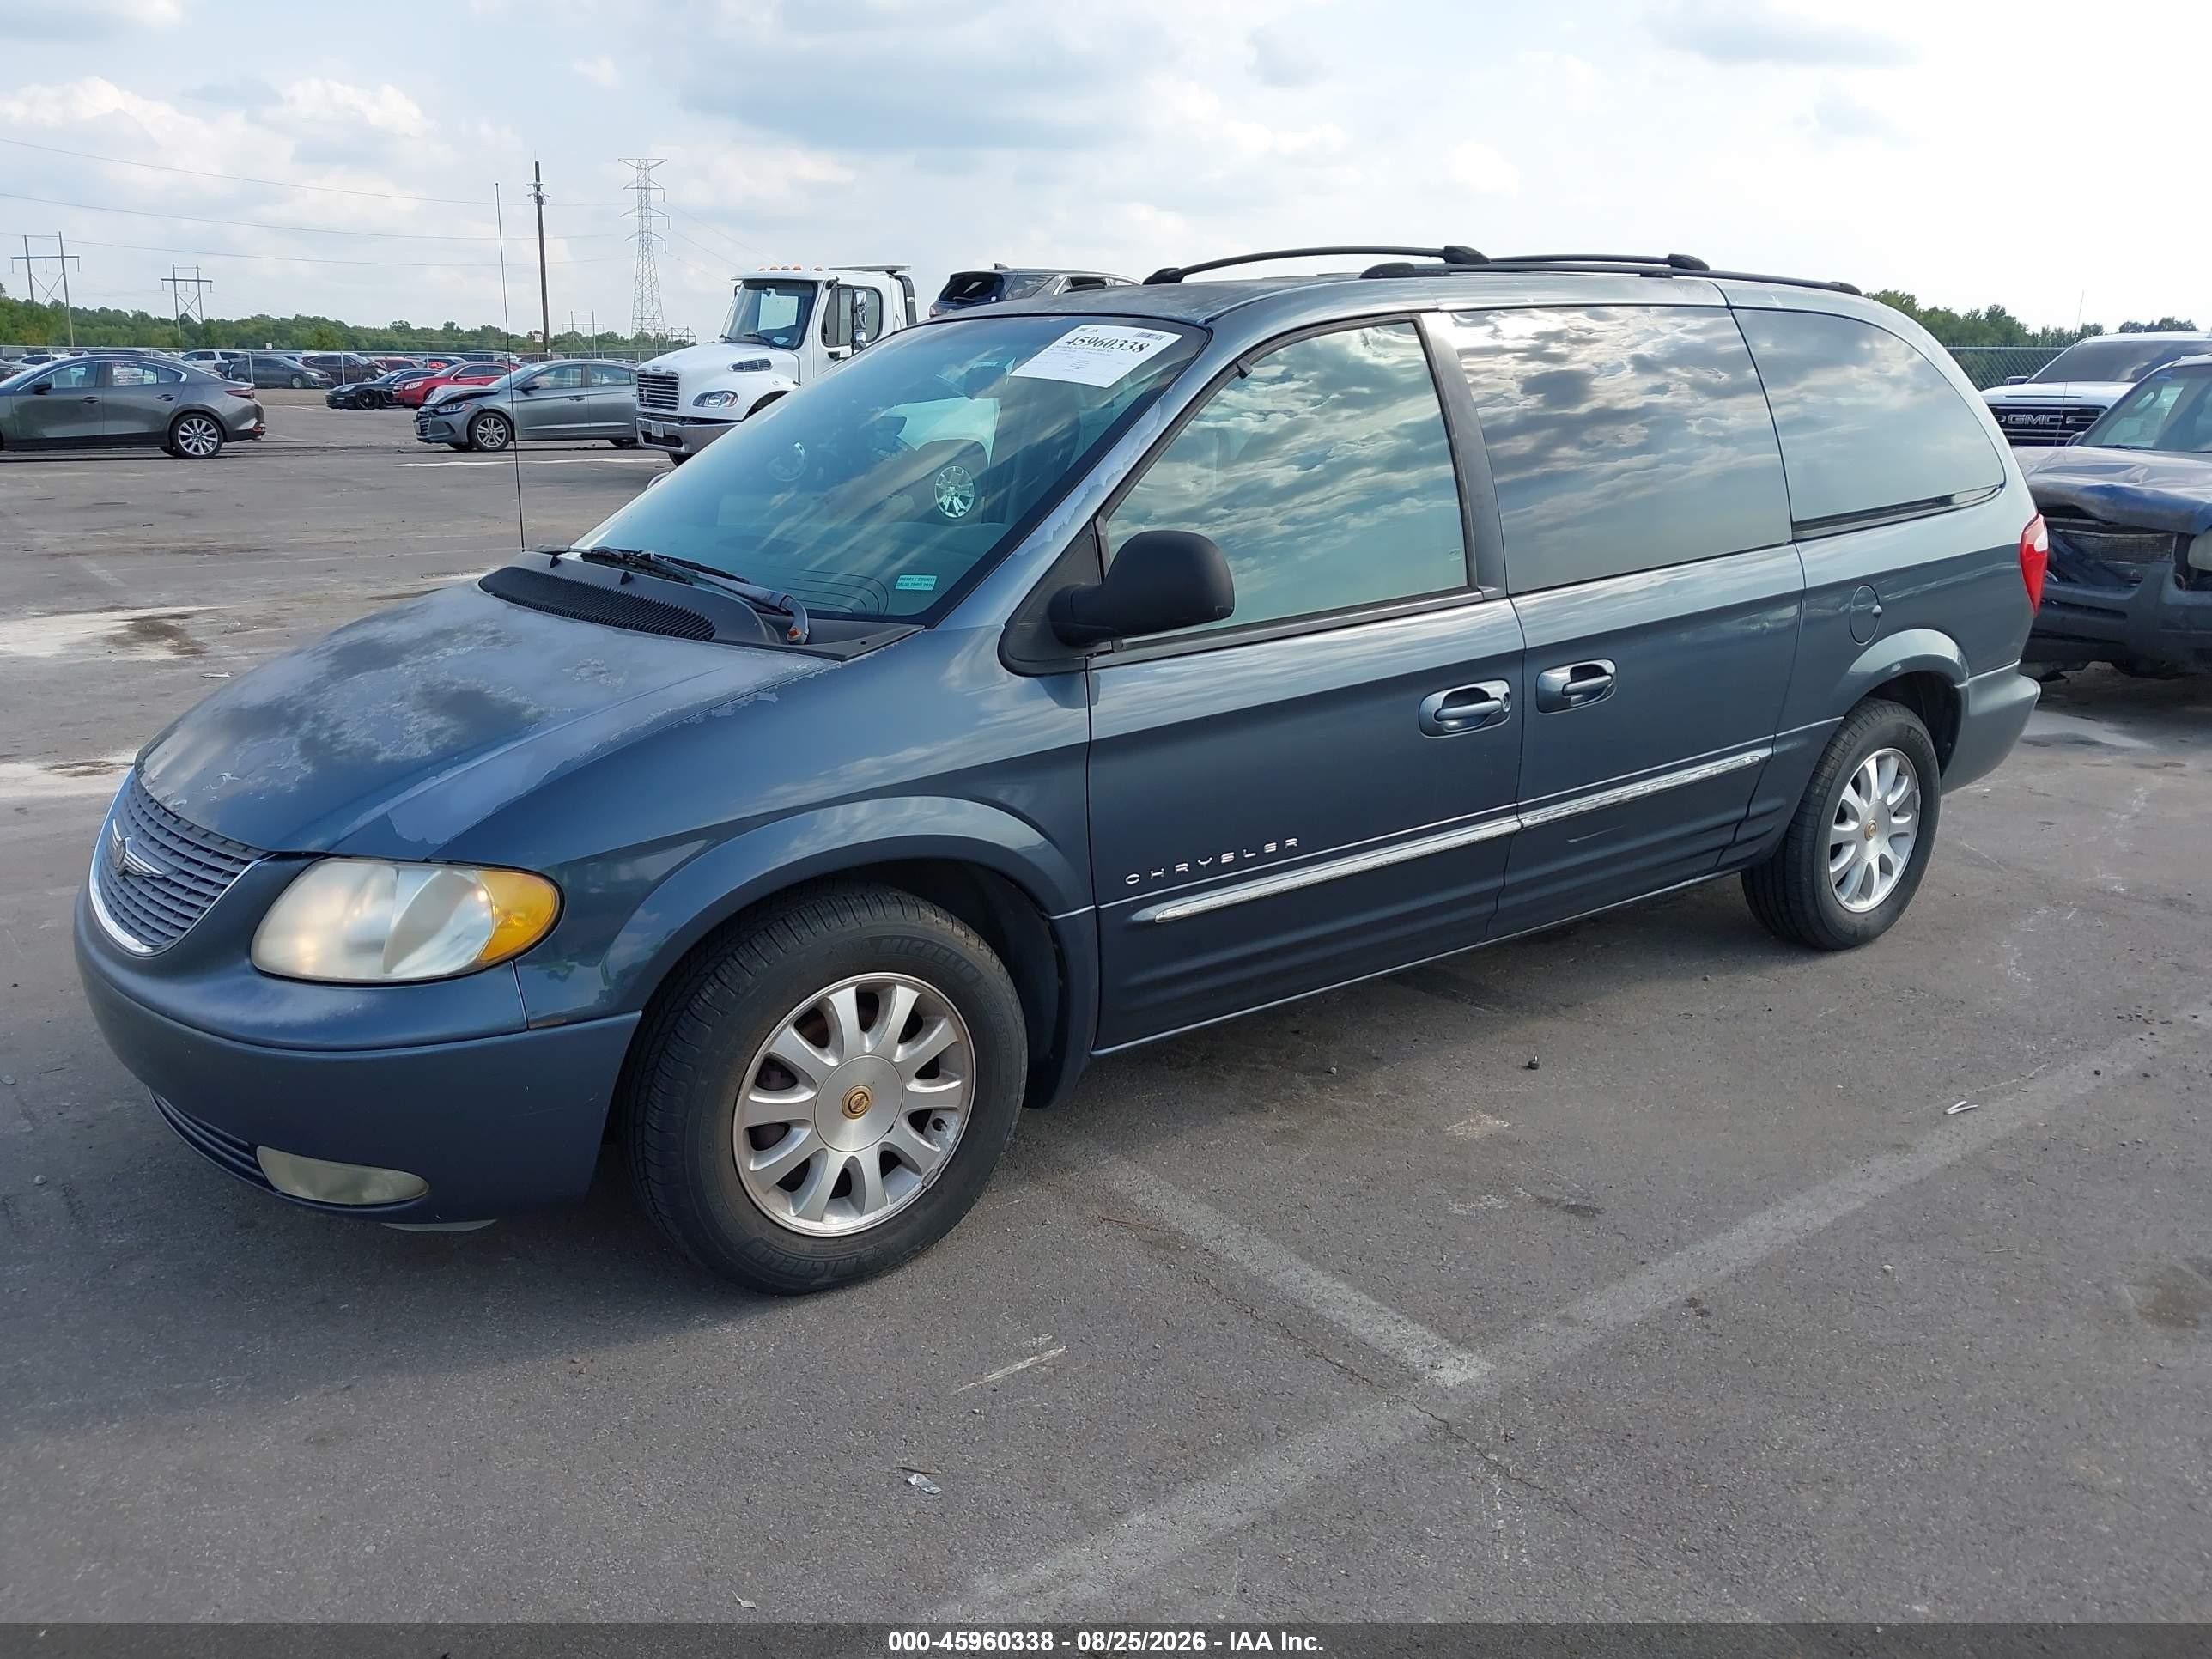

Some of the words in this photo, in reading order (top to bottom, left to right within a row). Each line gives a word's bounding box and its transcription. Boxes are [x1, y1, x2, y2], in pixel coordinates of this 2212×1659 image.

[1065, 336, 1151, 353] 45960338
[2008, 414, 2063, 425] GMC
[1125, 837, 1298, 885] CHRYSLER
[878, 938, 981, 985] MICHELIN
